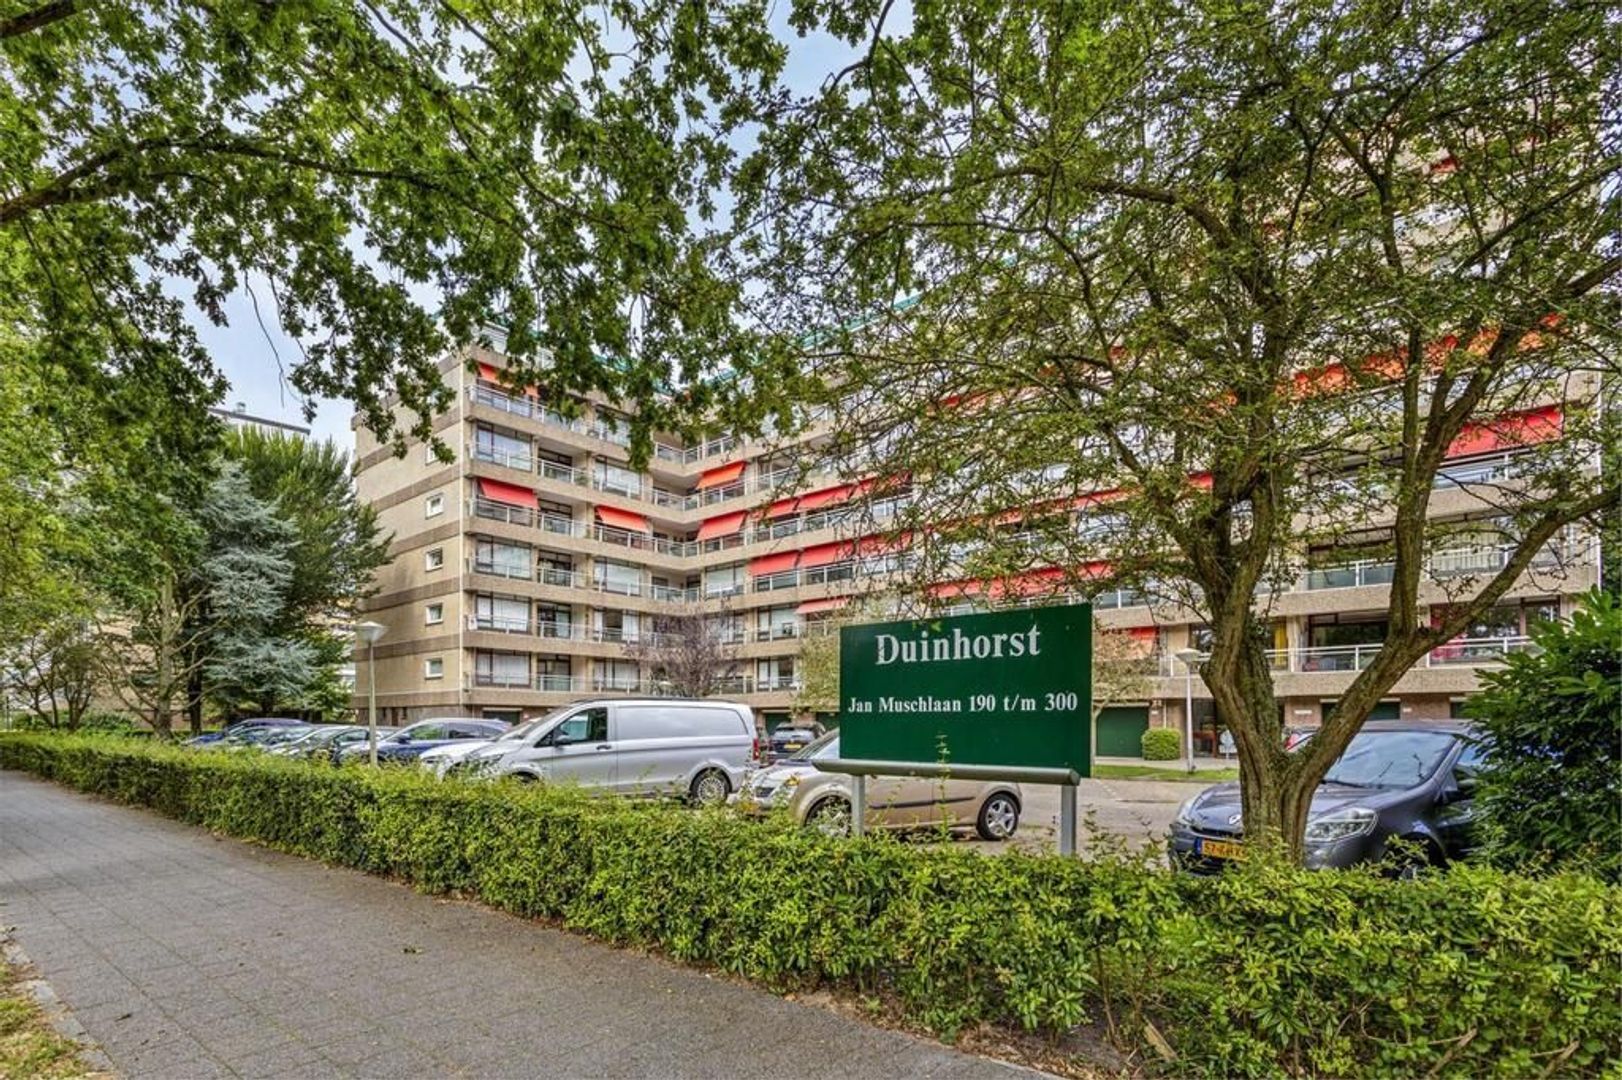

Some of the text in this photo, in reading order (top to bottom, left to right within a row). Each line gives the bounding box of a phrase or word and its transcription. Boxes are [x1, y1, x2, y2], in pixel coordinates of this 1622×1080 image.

[875, 624, 1041, 665] Duinhorst
[848, 692, 1078, 712] Jan Muschlaan 190 t/m 300
